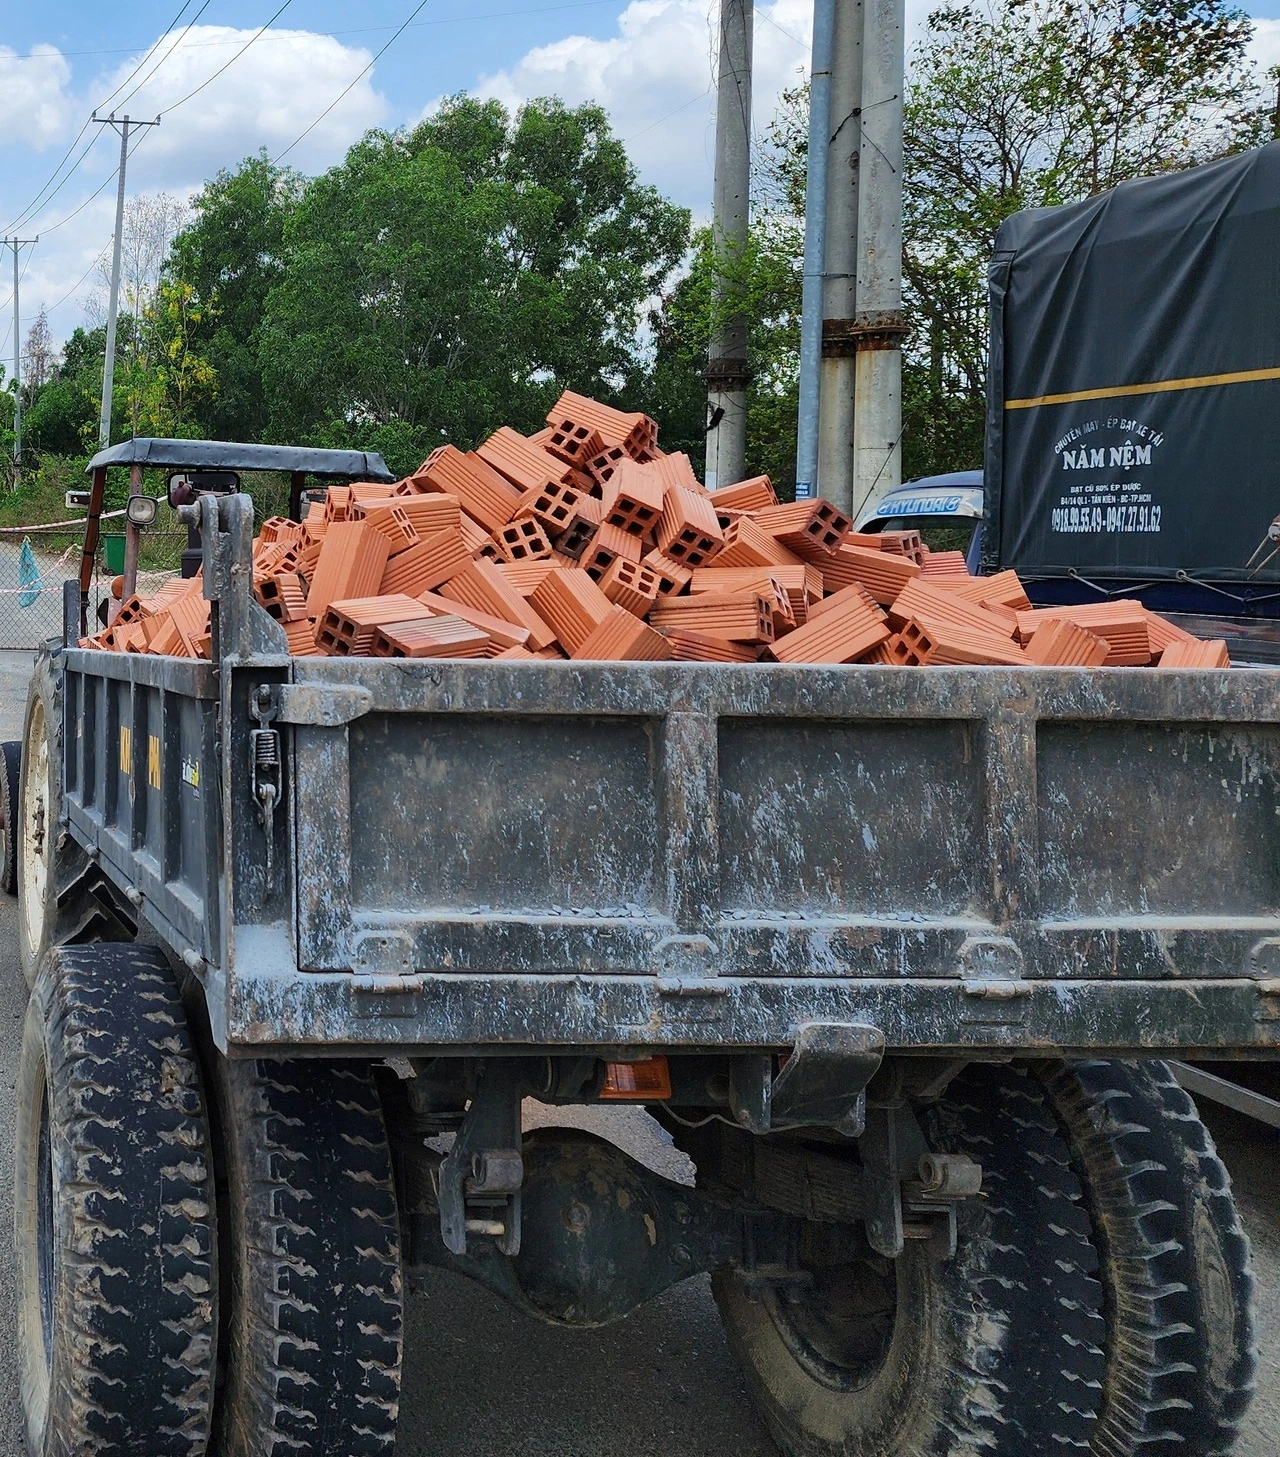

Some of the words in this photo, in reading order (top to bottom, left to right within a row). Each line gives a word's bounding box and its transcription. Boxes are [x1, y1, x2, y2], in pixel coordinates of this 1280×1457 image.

[1083, 420, 1099, 434] MAY
[1120, 418, 1137, 433] BẠT
[1136, 424, 1148, 437] XE
[1062, 443, 1105, 470] NĂM
[1109, 440, 1152, 470] NỆM
[890, 497, 948, 514] HYUNDAI
